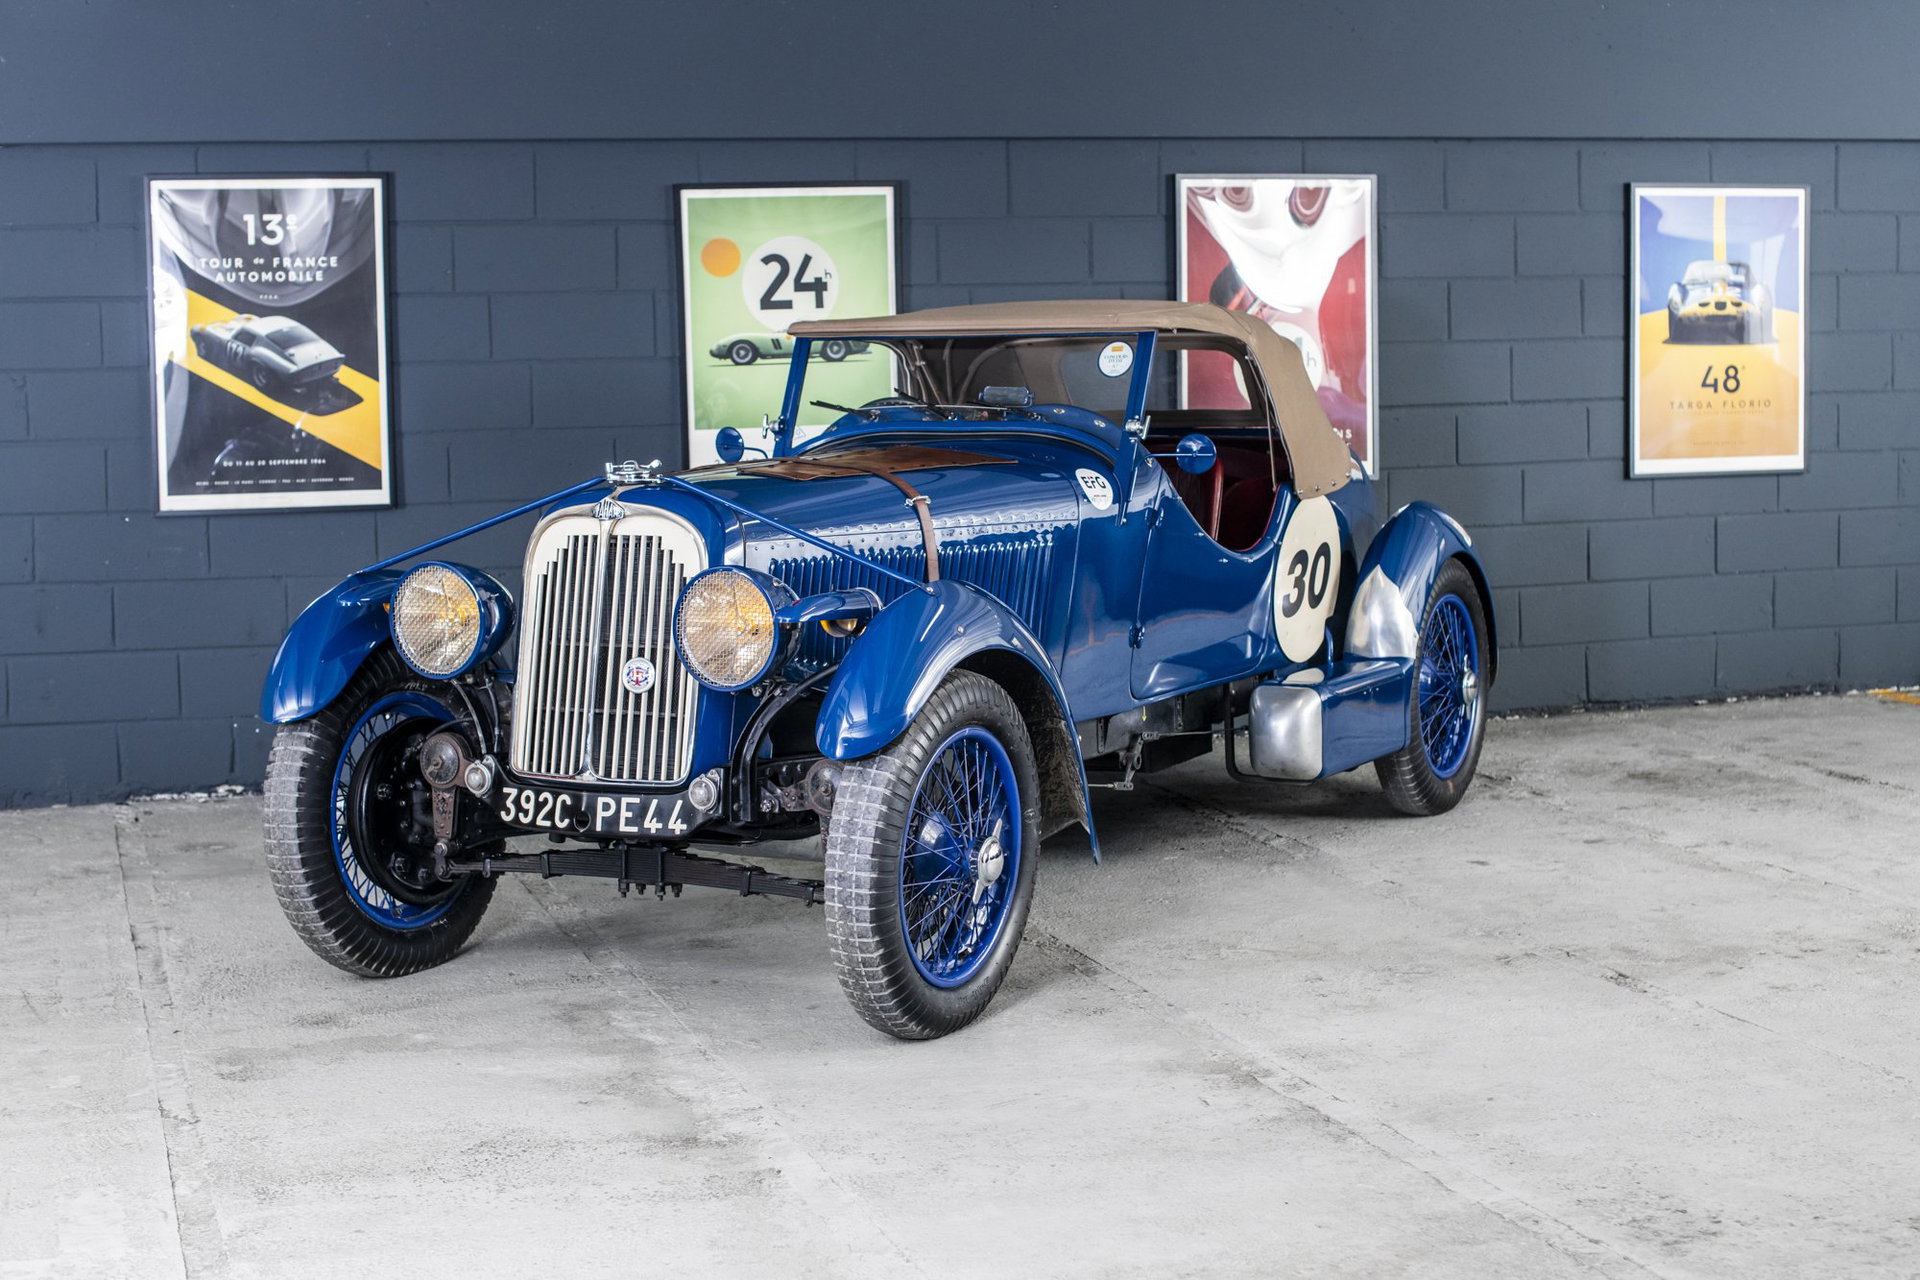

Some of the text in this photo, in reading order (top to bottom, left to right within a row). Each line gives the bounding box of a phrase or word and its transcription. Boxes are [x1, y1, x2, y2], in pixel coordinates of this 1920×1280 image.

[200, 256, 338, 269] TOUR de FRANCE
[215, 270, 324, 283] AUTOMOBILE
[1722, 399, 1772, 409] FLORIO
[1282, 542, 1331, 618] 30
[500, 787, 572, 829] 392C
